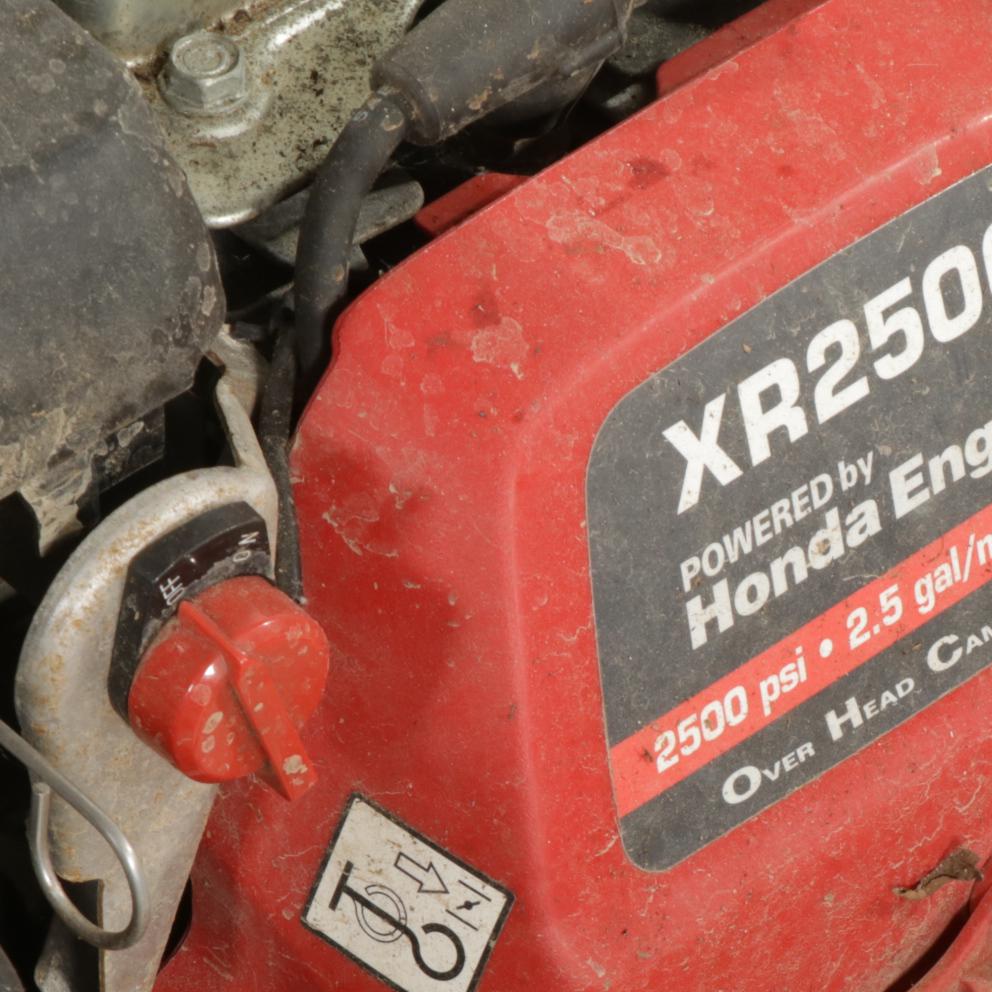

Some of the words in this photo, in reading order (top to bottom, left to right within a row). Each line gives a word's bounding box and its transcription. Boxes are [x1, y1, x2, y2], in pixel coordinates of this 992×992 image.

[233, 531, 260, 562] ON
[680, 480, 834, 592] POWERED
[839, 452, 875, 495] by
[685, 500, 881, 649] Honda
[653, 685, 749, 774] 2500
[760, 646, 807, 716] psi
[846, 584, 904, 649] 2.5
